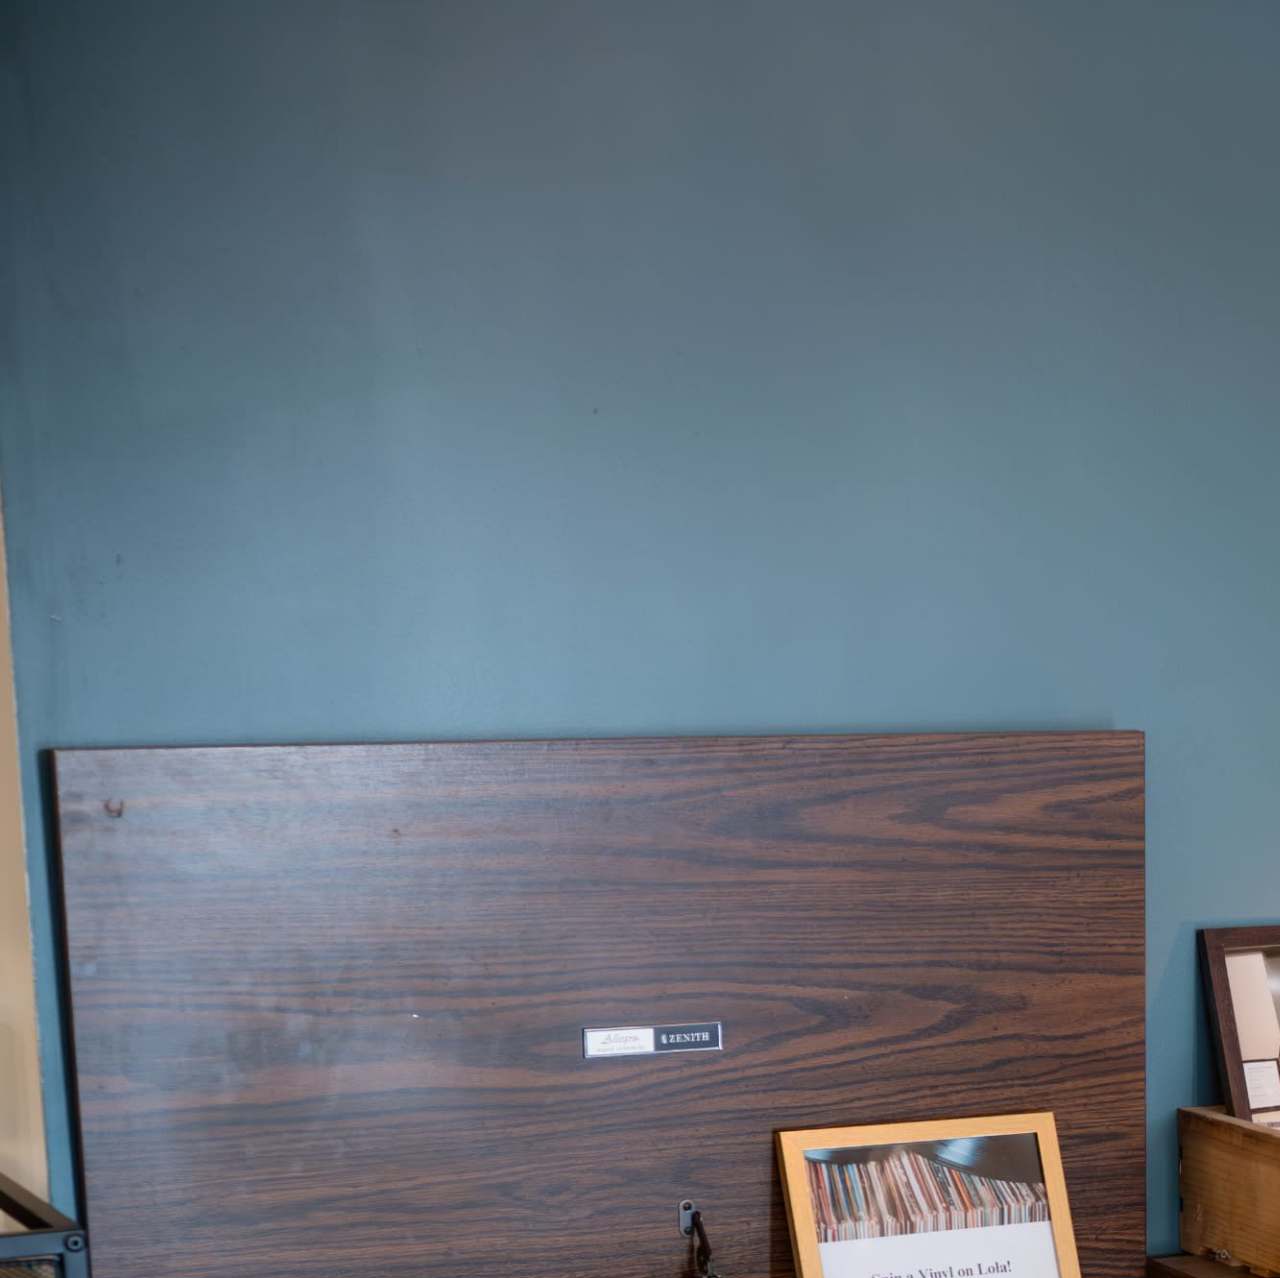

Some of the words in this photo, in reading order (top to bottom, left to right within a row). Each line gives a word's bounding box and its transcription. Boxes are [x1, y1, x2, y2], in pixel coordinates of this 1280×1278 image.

[668, 1032, 710, 1044] ZENITH
[958, 1268, 973, 1278] on
[978, 1261, 1012, 1275] Lola!
